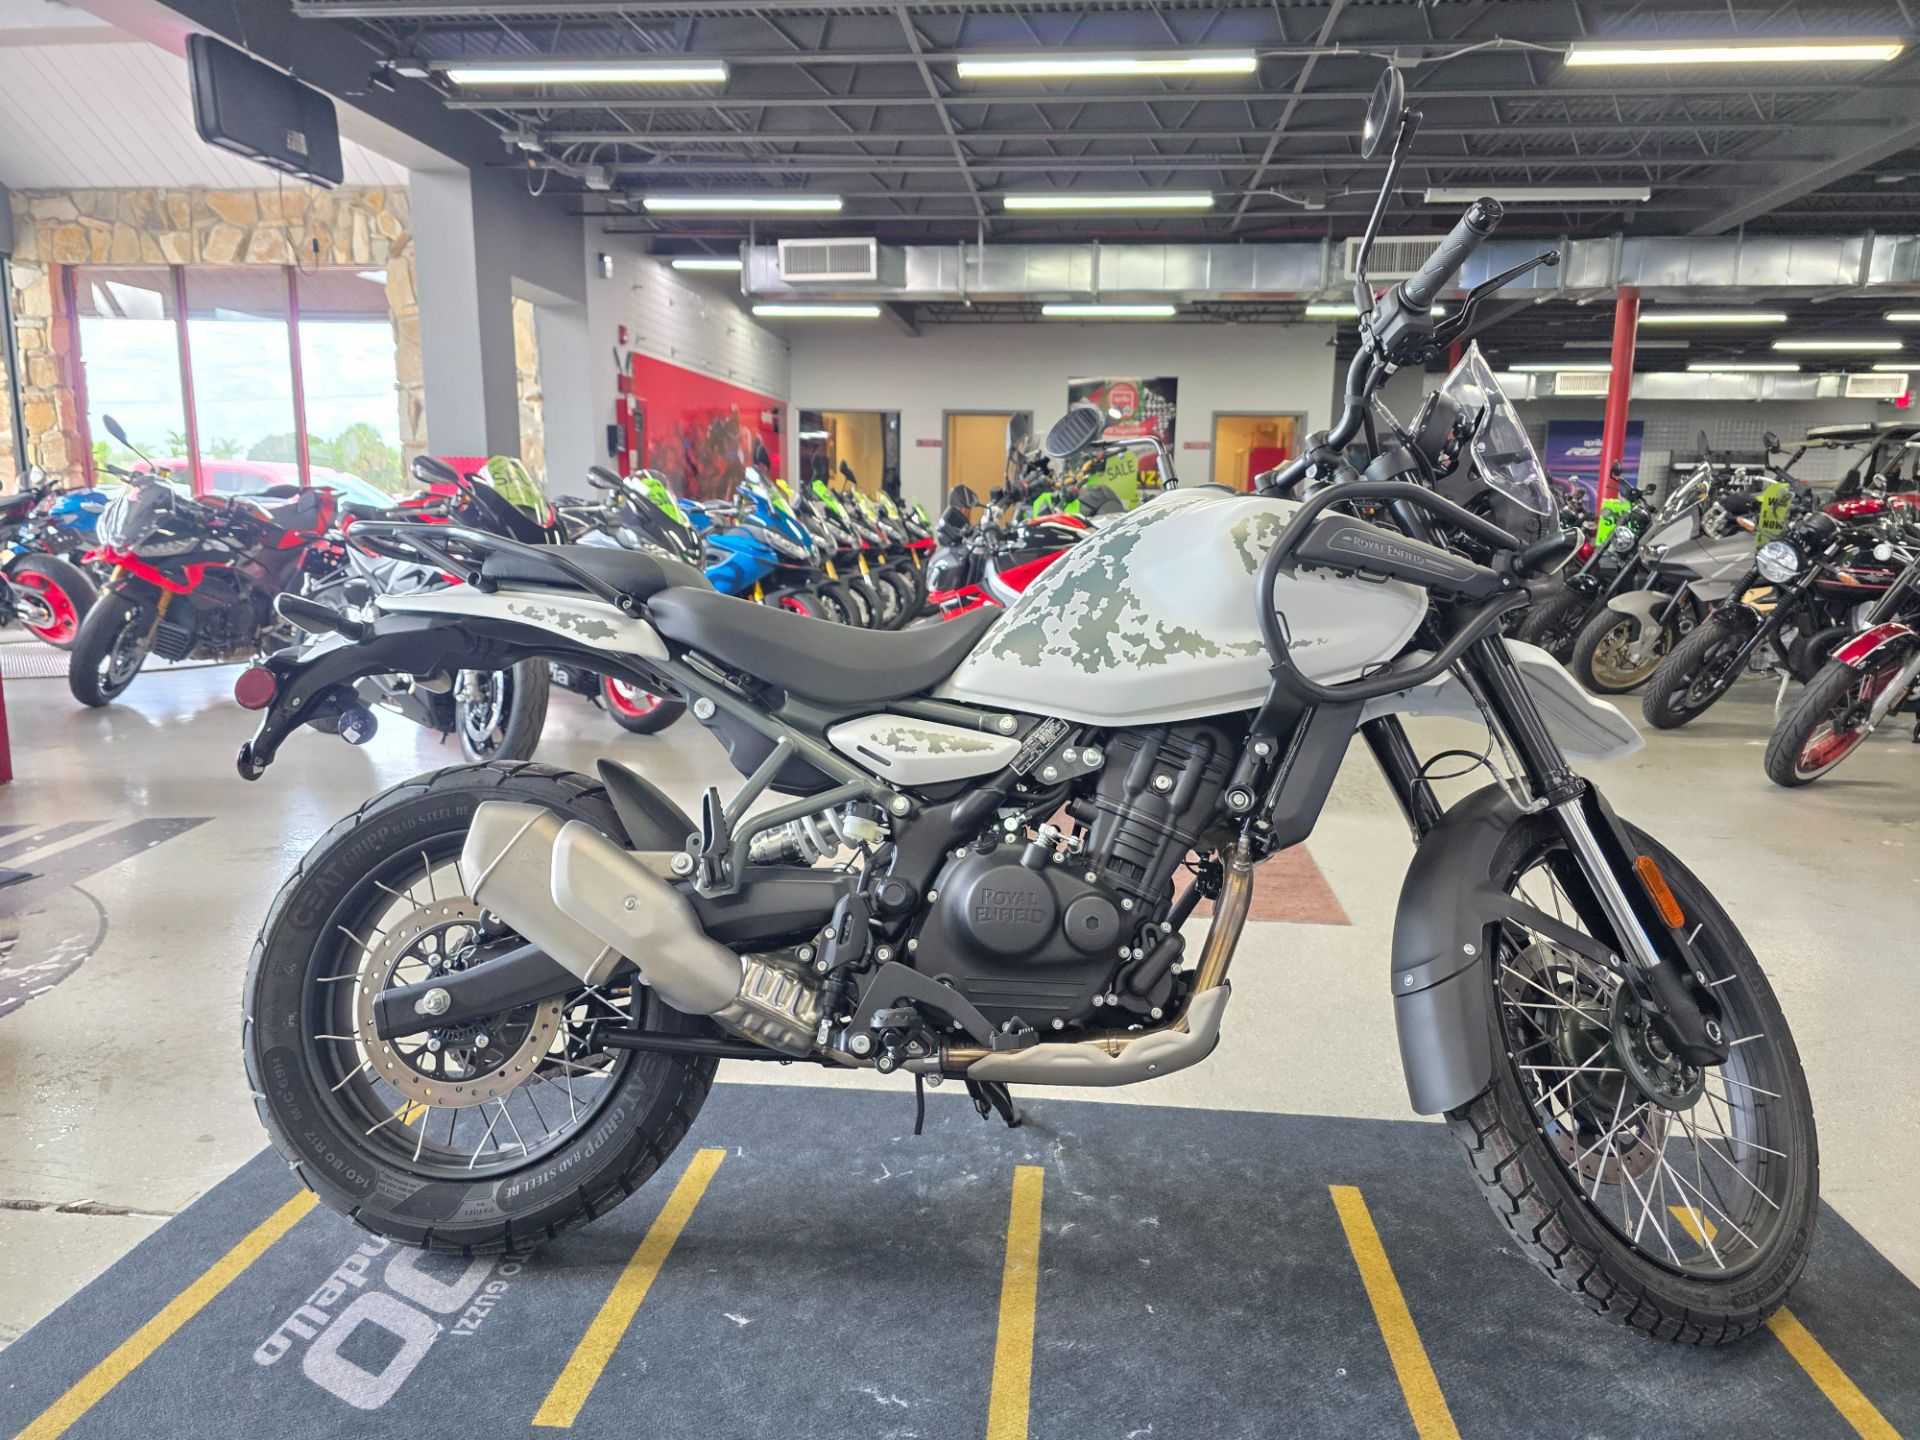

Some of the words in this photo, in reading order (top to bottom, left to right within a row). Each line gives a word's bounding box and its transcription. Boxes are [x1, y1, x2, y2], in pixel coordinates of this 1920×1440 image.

[1106, 460, 1136, 481] SALE
[1762, 520, 1783, 530] NOW
[1353, 535, 1386, 553] ROYAL
[1387, 545, 1425, 564] ENFIELD
[287, 862, 345, 930] CEAT
[392, 818, 416, 834] RAD
[418, 807, 453, 824] STEEL
[981, 888, 1039, 907] ROYAL
[976, 906, 1047, 923] ENFIELD
[304, 1131, 327, 1152] R17
[586, 1107, 626, 1159] GRIPP
[325, 1152, 370, 1189] 140/80
[558, 1150, 582, 1172] RAD
[525, 1167, 559, 1192] STEEL
[504, 1186, 519, 1199] RE
[252, 1233, 391, 1366] ndello
[450, 1280, 510, 1336] GUZZI
